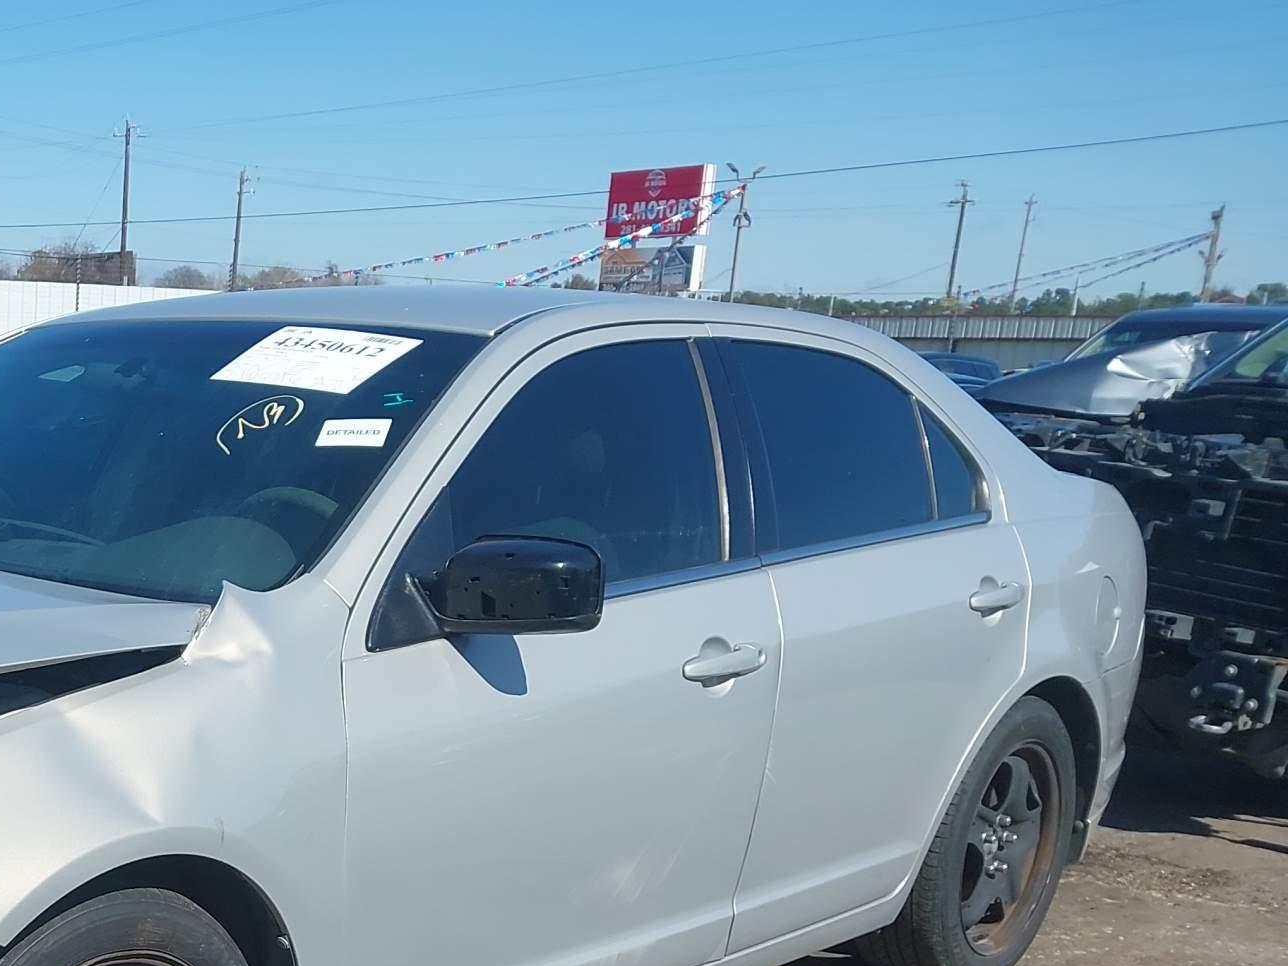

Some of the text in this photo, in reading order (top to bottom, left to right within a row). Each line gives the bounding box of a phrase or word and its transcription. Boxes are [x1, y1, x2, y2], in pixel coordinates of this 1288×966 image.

[630, 198, 700, 221] MOTORS
[274, 336, 387, 358] 43450612
[326, 428, 382, 437] DETAILED
